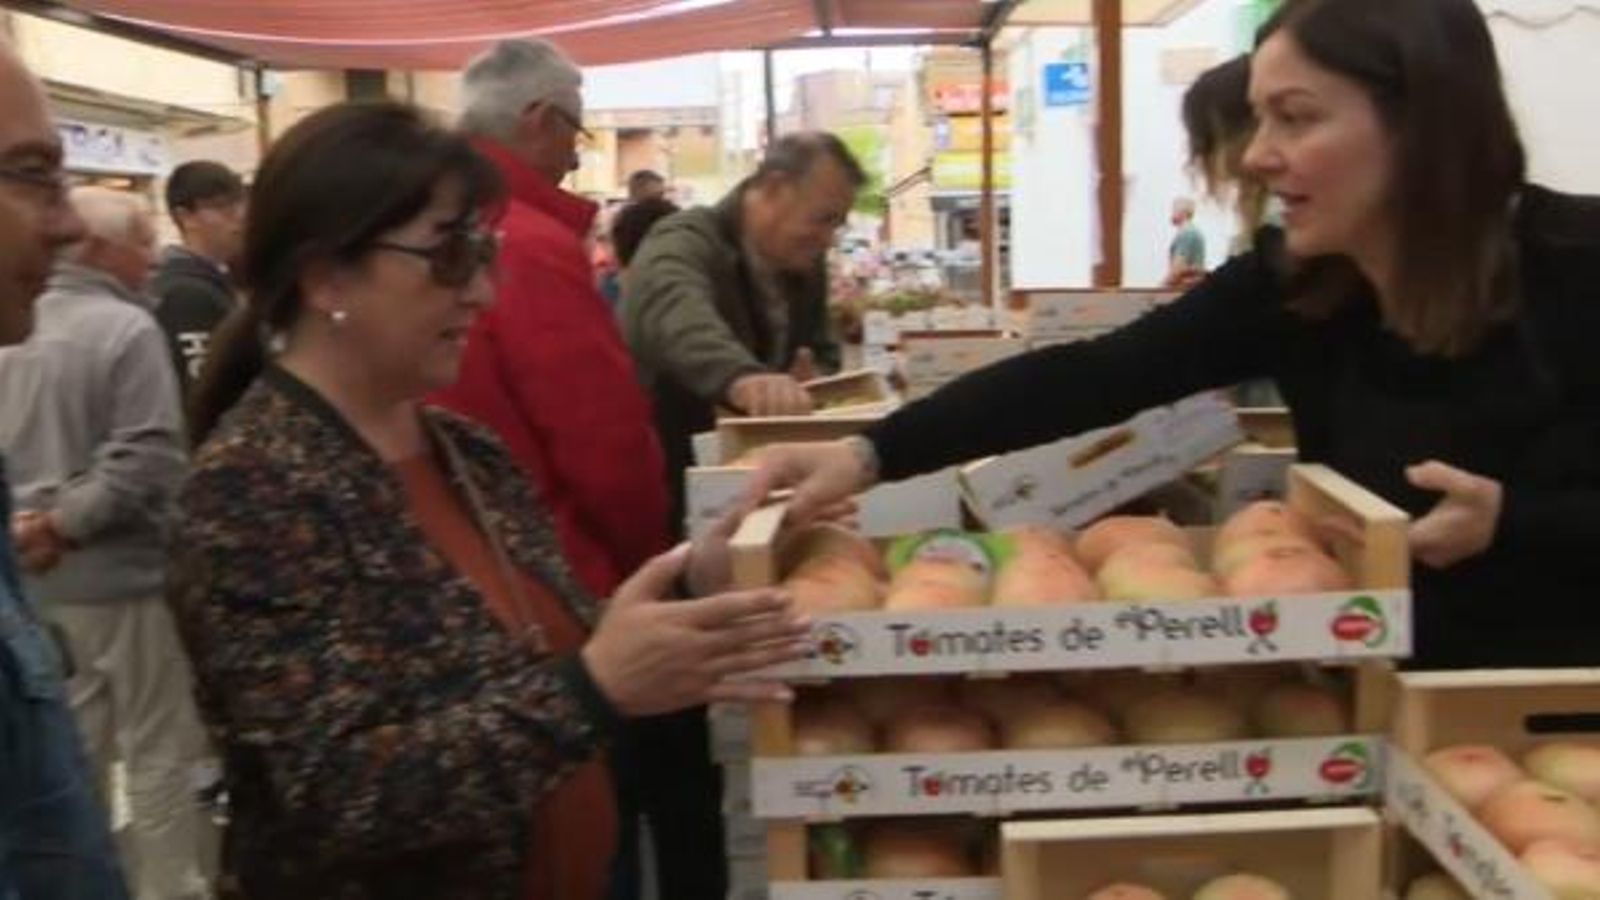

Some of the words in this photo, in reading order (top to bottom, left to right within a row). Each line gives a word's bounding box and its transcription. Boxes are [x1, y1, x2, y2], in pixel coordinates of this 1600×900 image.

[886, 619, 1045, 658] Tomates
[1061, 618, 1105, 650] de
[901, 763, 1052, 798] Tomates
[1066, 761, 1109, 793] de
